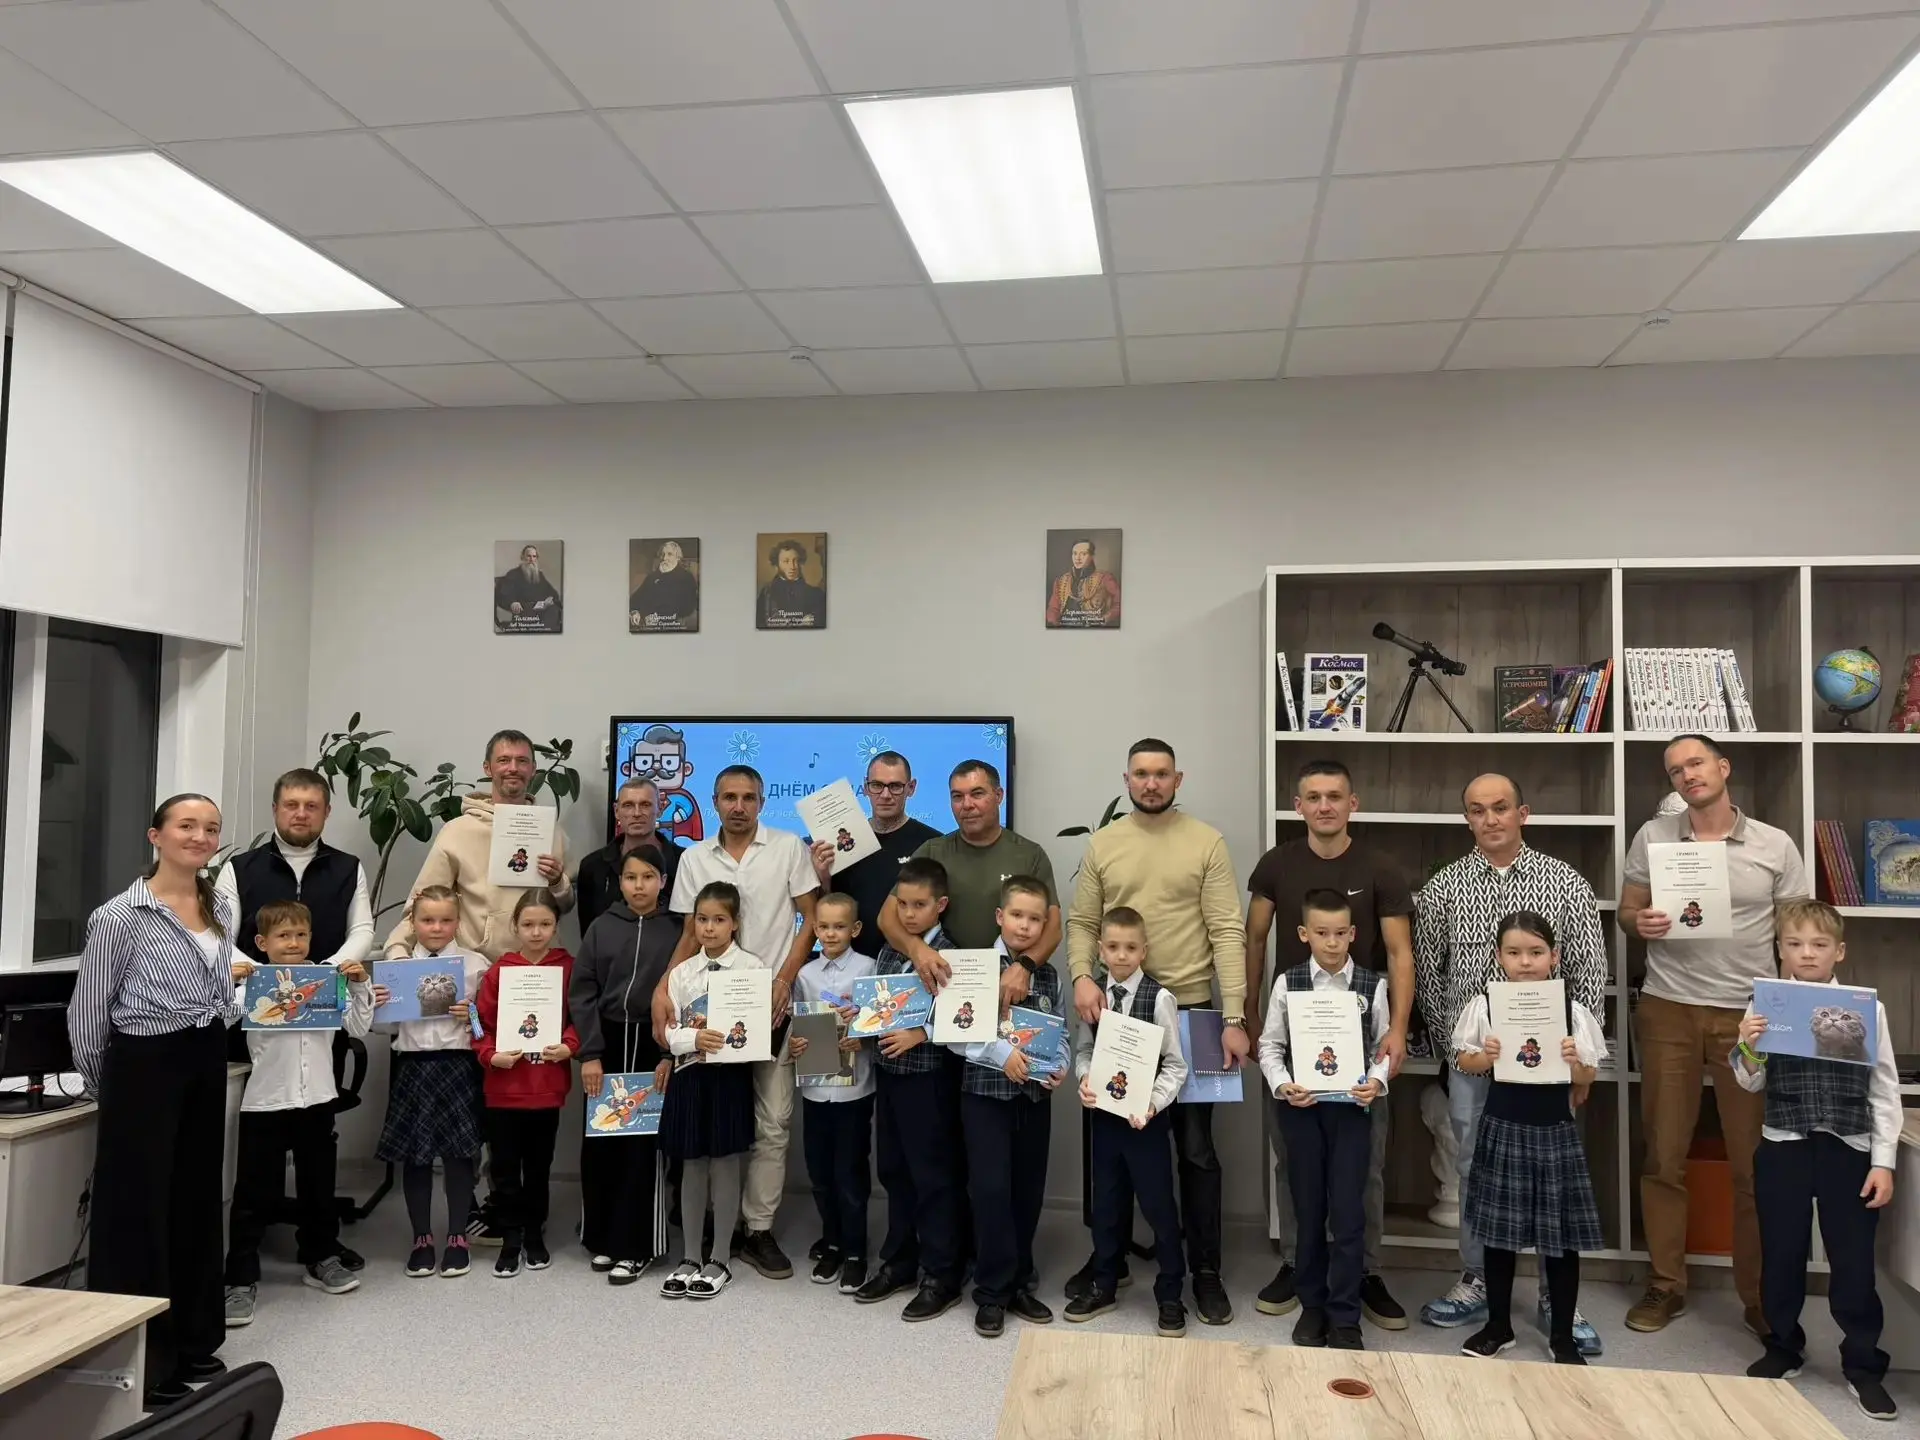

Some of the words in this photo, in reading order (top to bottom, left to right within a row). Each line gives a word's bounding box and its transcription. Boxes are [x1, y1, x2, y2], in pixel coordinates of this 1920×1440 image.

[1318, 658, 1359, 668] Космос
[1502, 680, 1548, 688] АСТРОНОМИЯ
[768, 781, 815, 799] ДНЁМ
